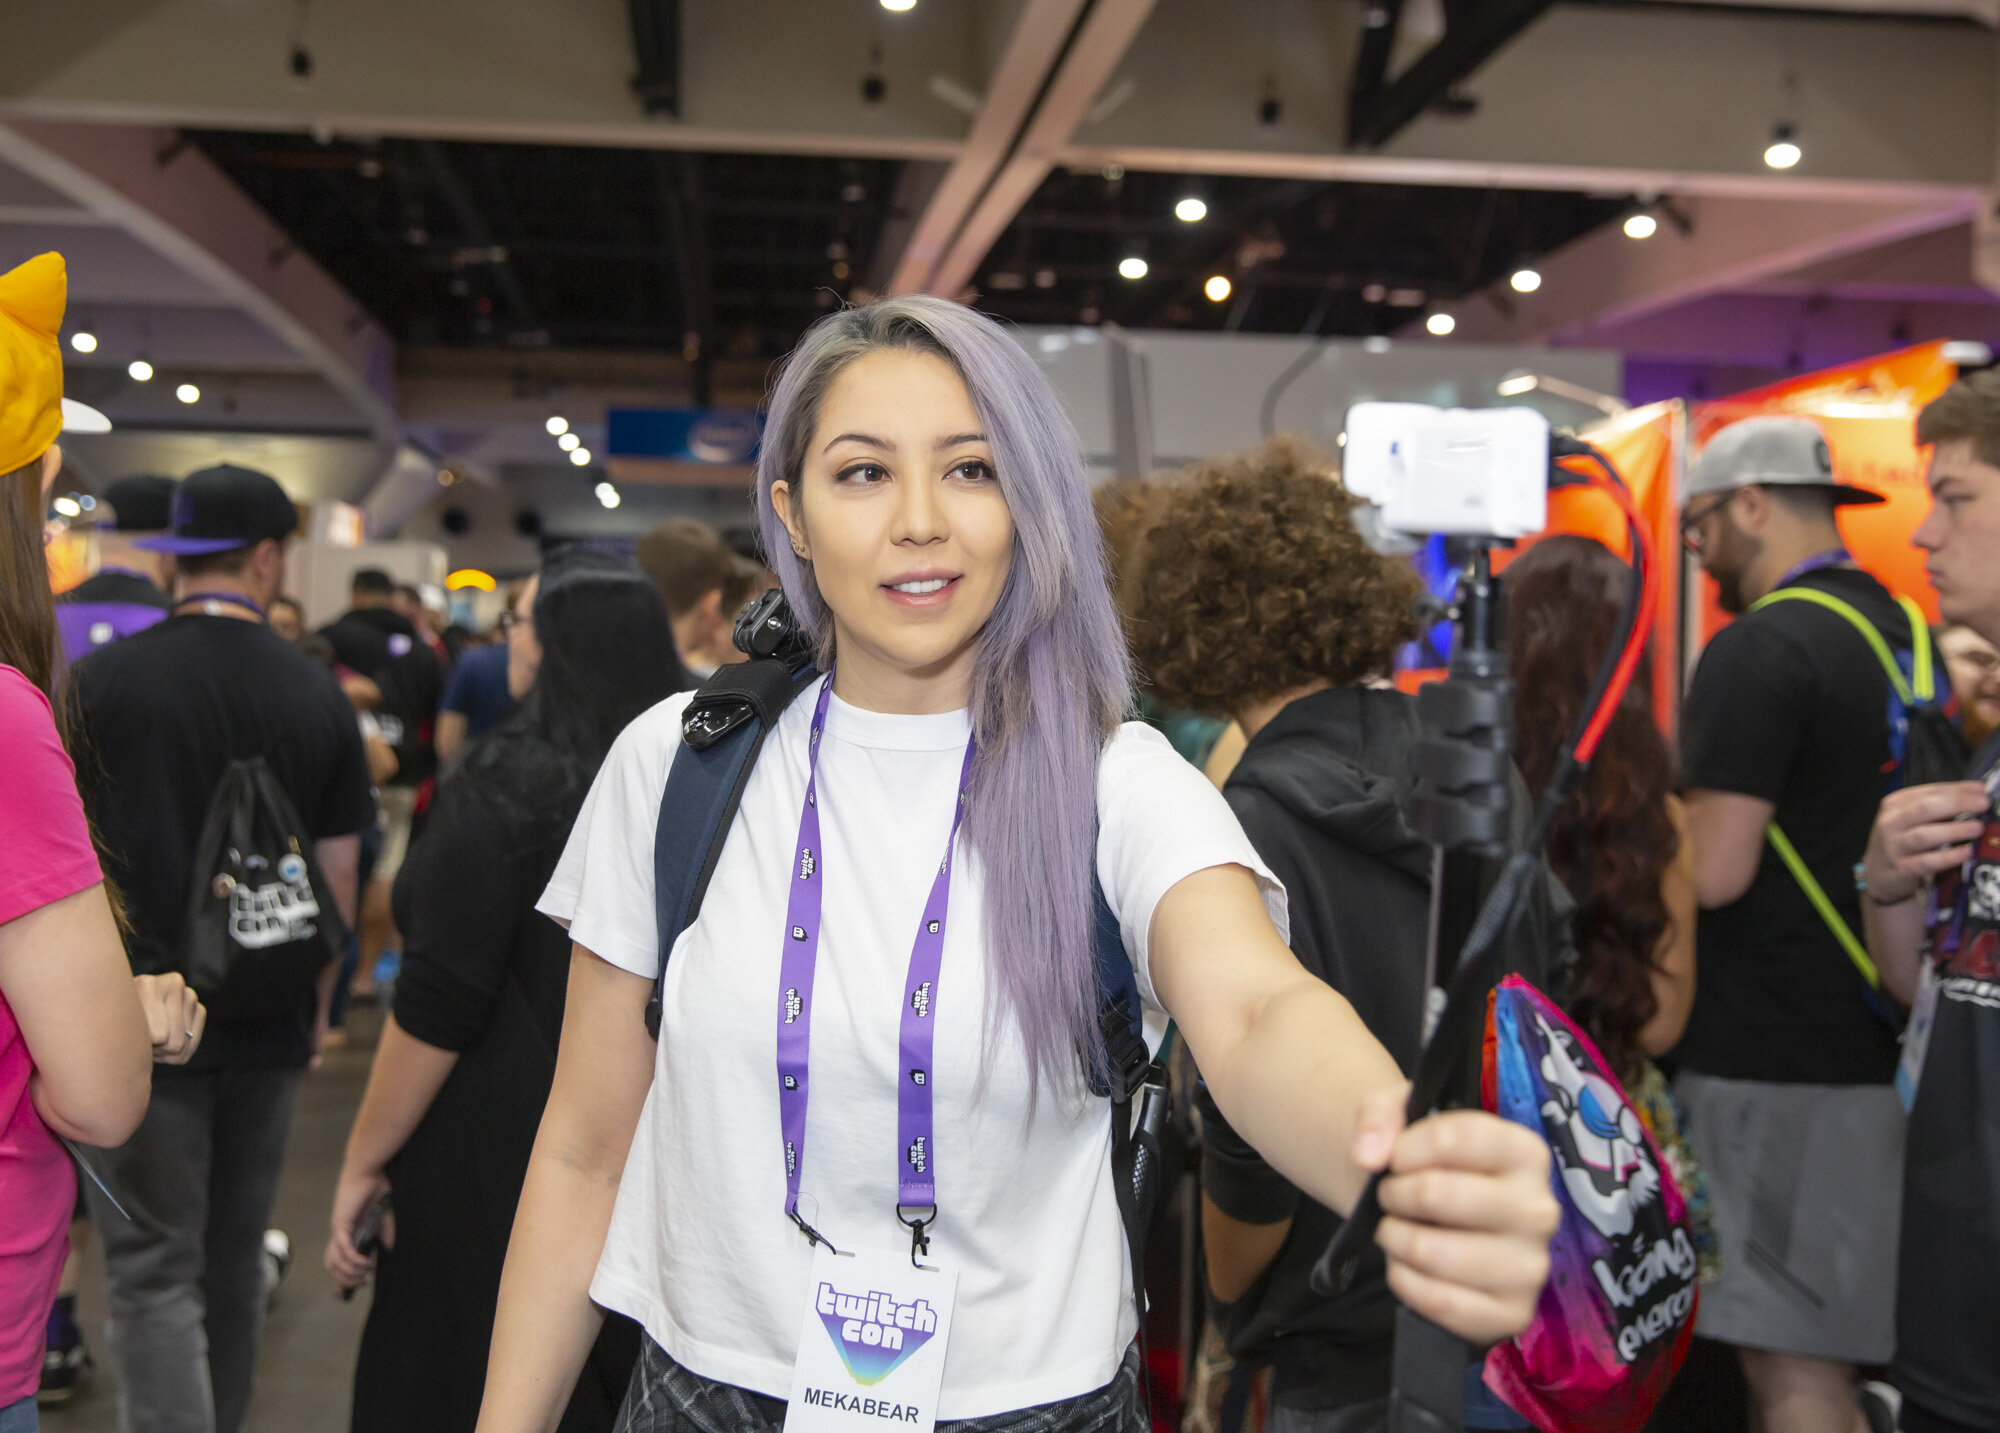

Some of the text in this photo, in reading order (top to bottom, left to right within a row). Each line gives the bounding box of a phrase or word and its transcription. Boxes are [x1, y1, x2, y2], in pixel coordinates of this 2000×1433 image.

[800, 848, 810, 880] twitch
[784, 988, 795, 1024] twitch
[793, 997, 801, 1016] con
[913, 990, 922, 1008] con
[917, 982, 931, 1017] twitch
[910, 1145, 918, 1164] con
[916, 1136, 926, 1172] twitch
[816, 1282, 938, 1335] twitch
[841, 1319, 904, 1351] con
[804, 1387, 920, 1424] MEKABEAR
